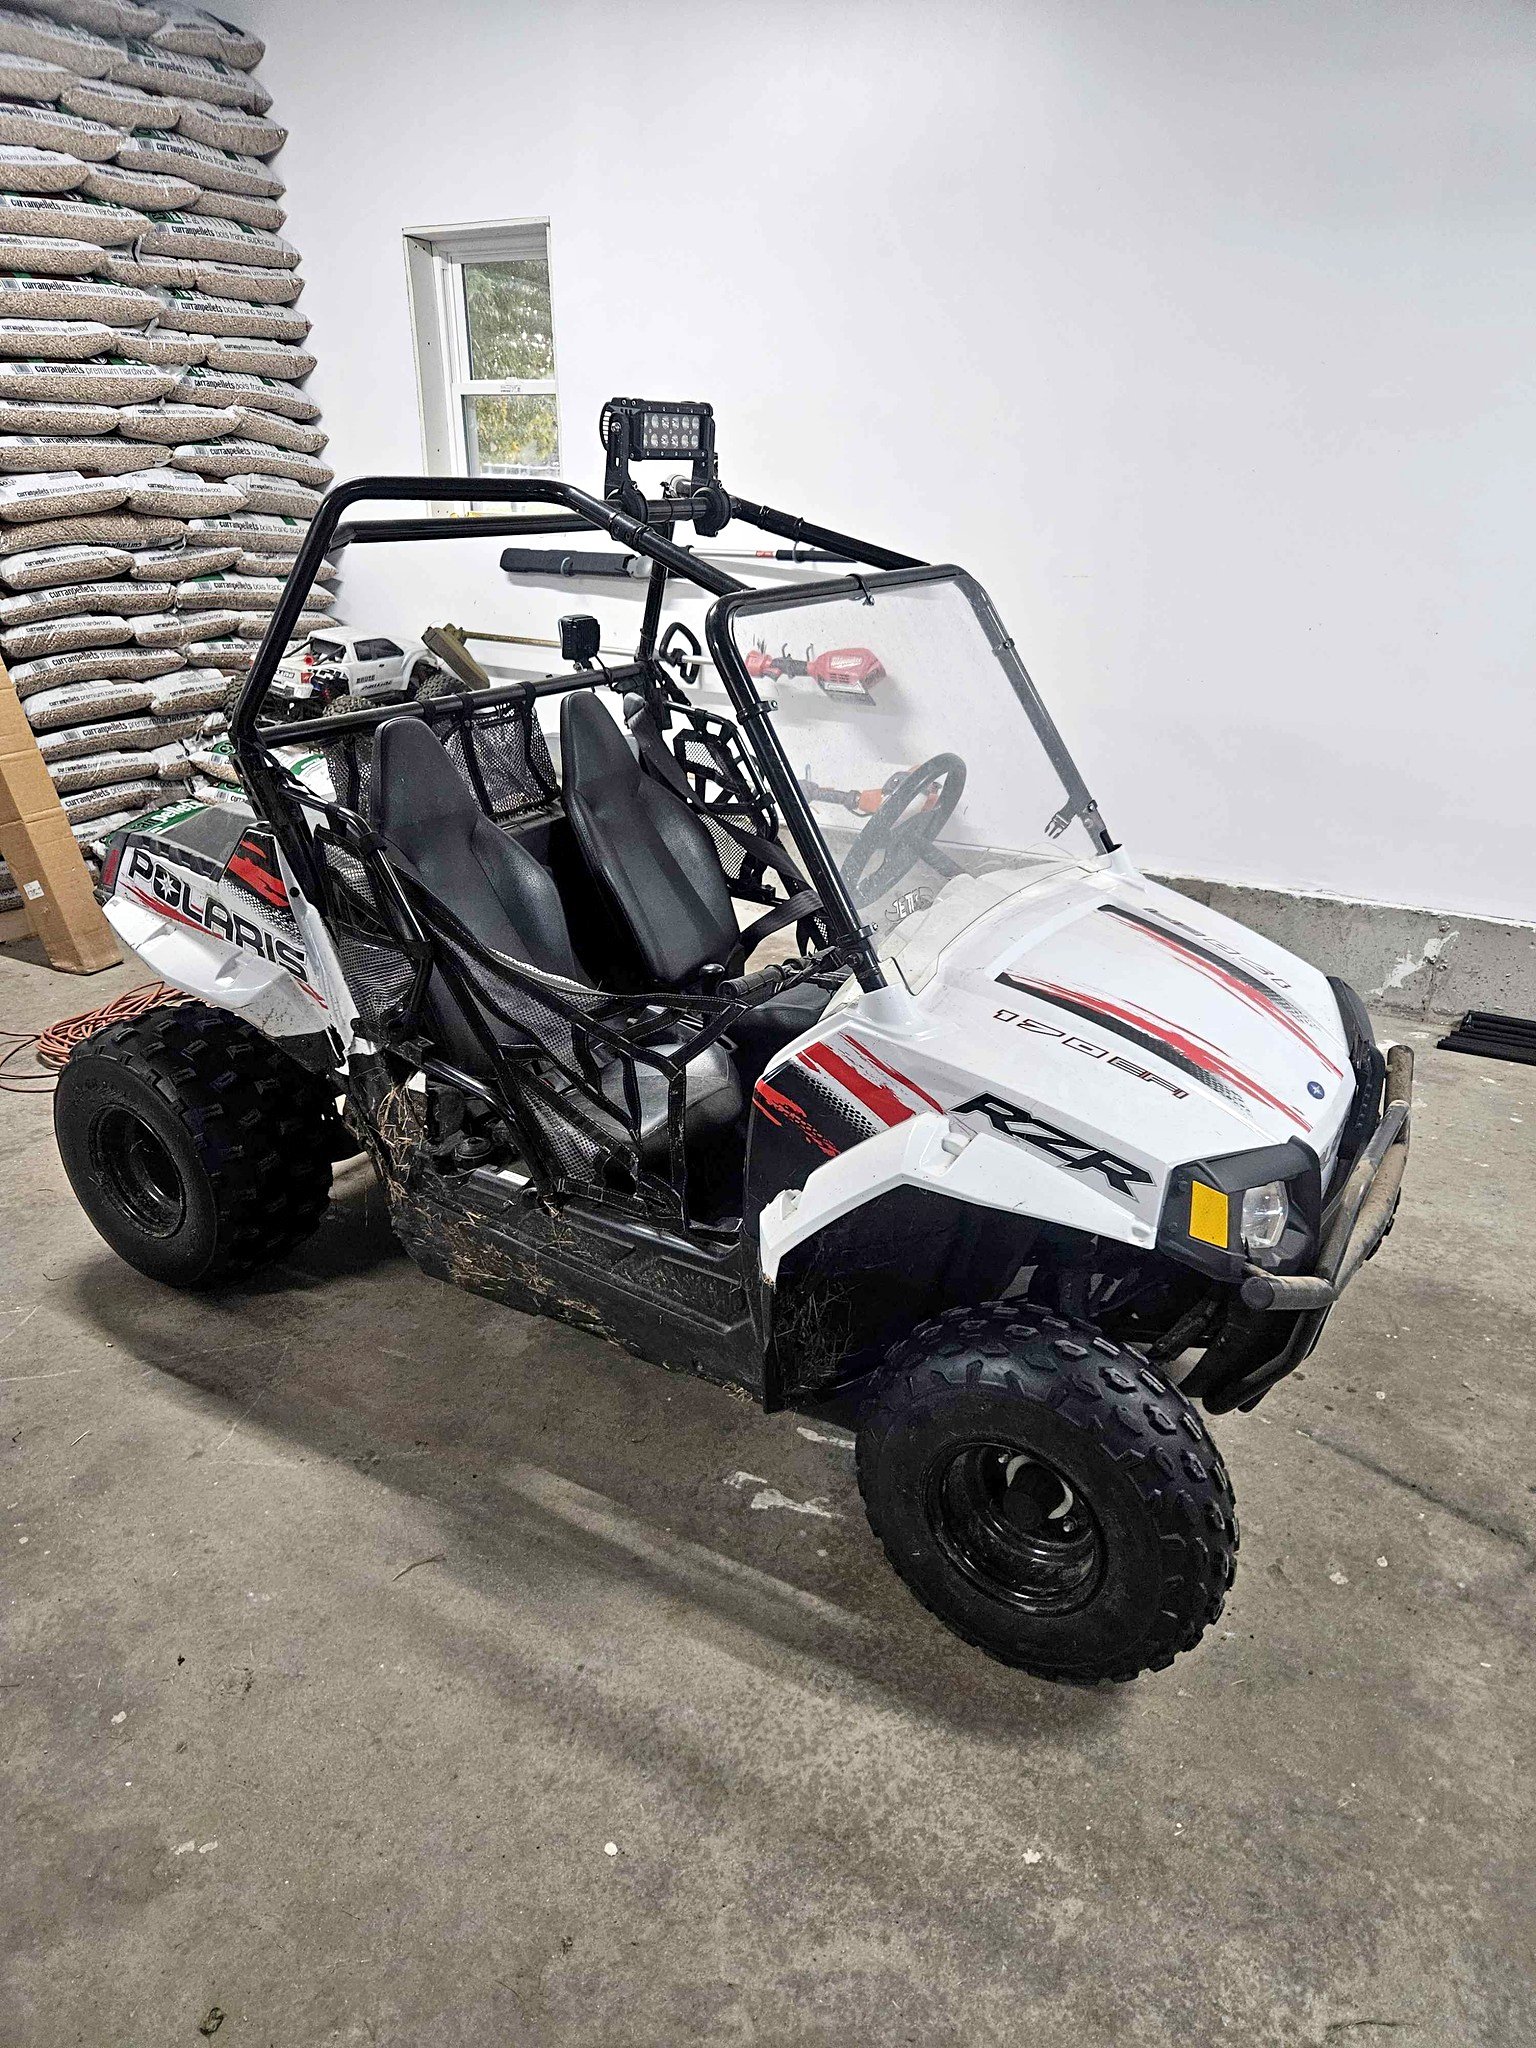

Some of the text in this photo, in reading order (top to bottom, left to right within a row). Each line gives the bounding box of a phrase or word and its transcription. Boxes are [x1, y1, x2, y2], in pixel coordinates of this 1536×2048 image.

[49, 584, 97, 599] curranpellets
[52, 651, 99, 666] curranpellets
[82, 721, 128, 736] curranpellets
[65, 790, 111, 808] curranpellets
[128, 848, 308, 984] POLARIS
[950, 1092, 1155, 1202] RZR
